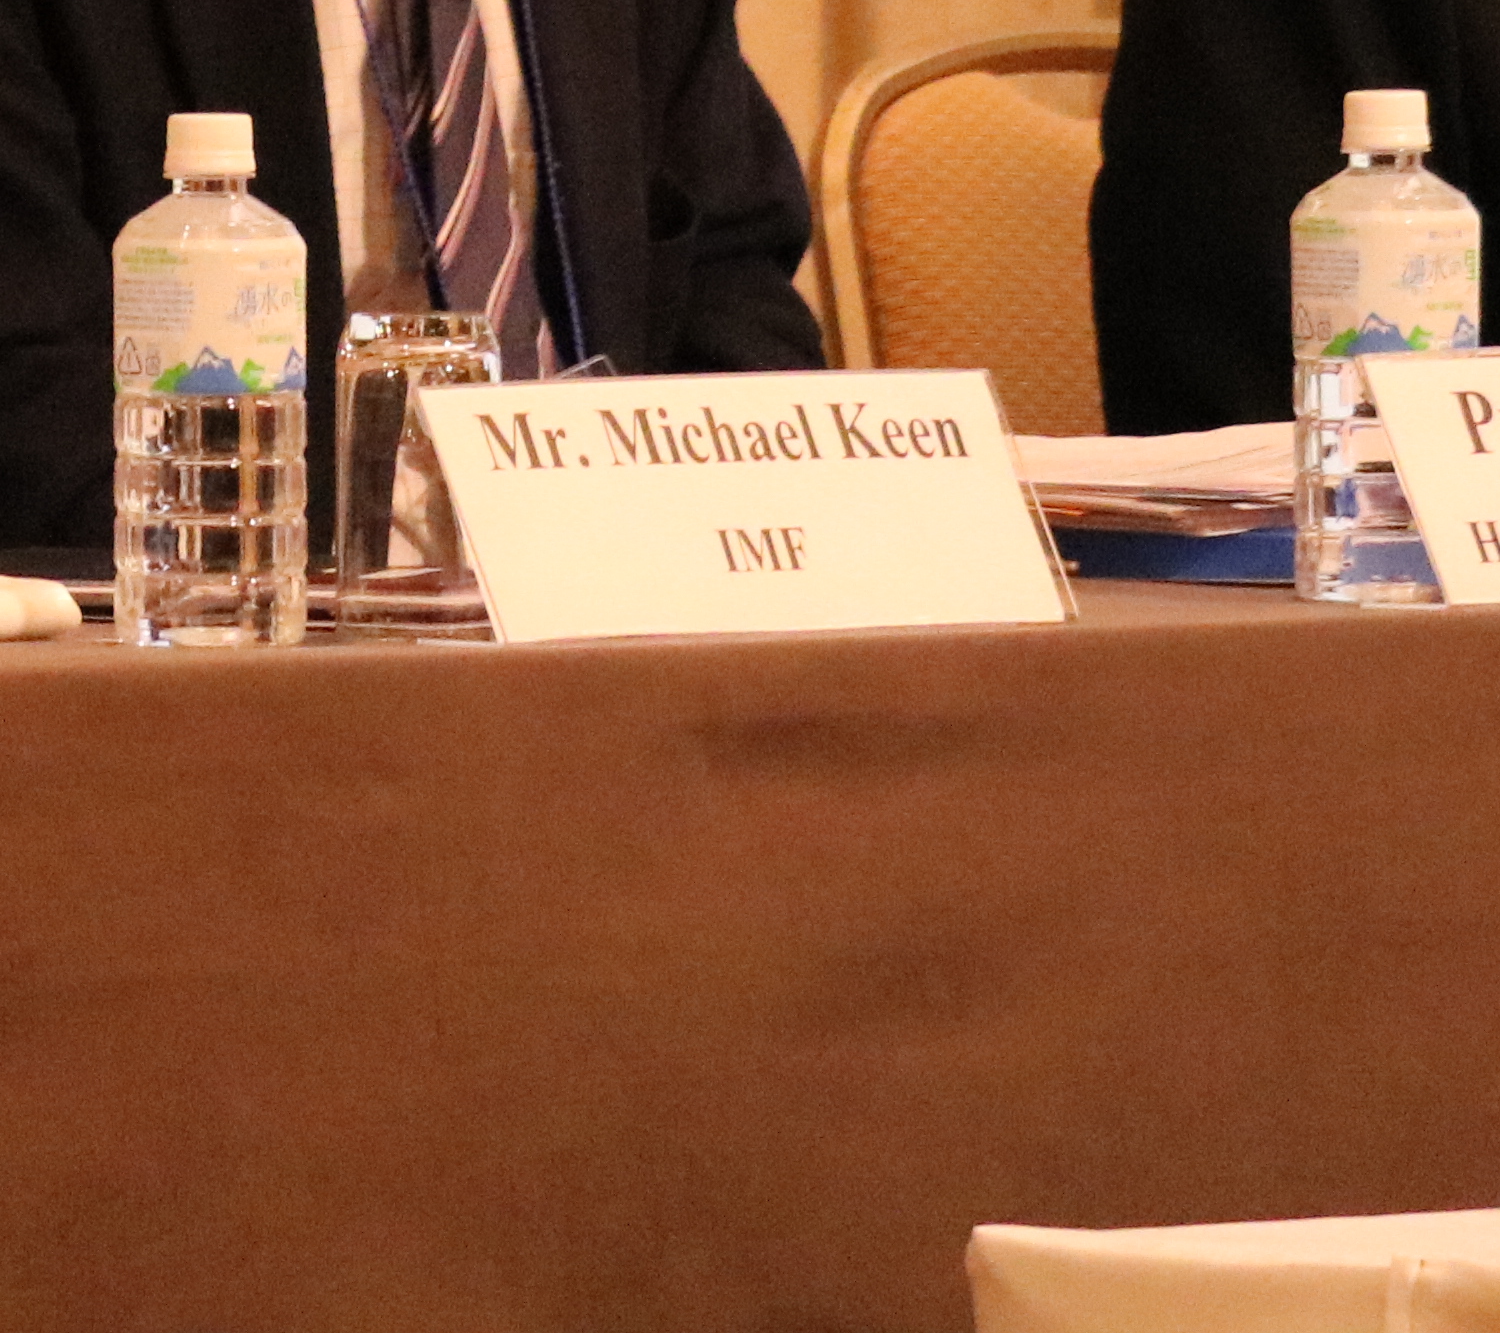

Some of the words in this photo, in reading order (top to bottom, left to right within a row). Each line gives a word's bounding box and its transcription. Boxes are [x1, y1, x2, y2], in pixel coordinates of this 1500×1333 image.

[474, 412, 590, 471] Mr.
[597, 403, 822, 466] Michael
[827, 401, 970, 460] Keen
[717, 526, 809, 573] IMF
